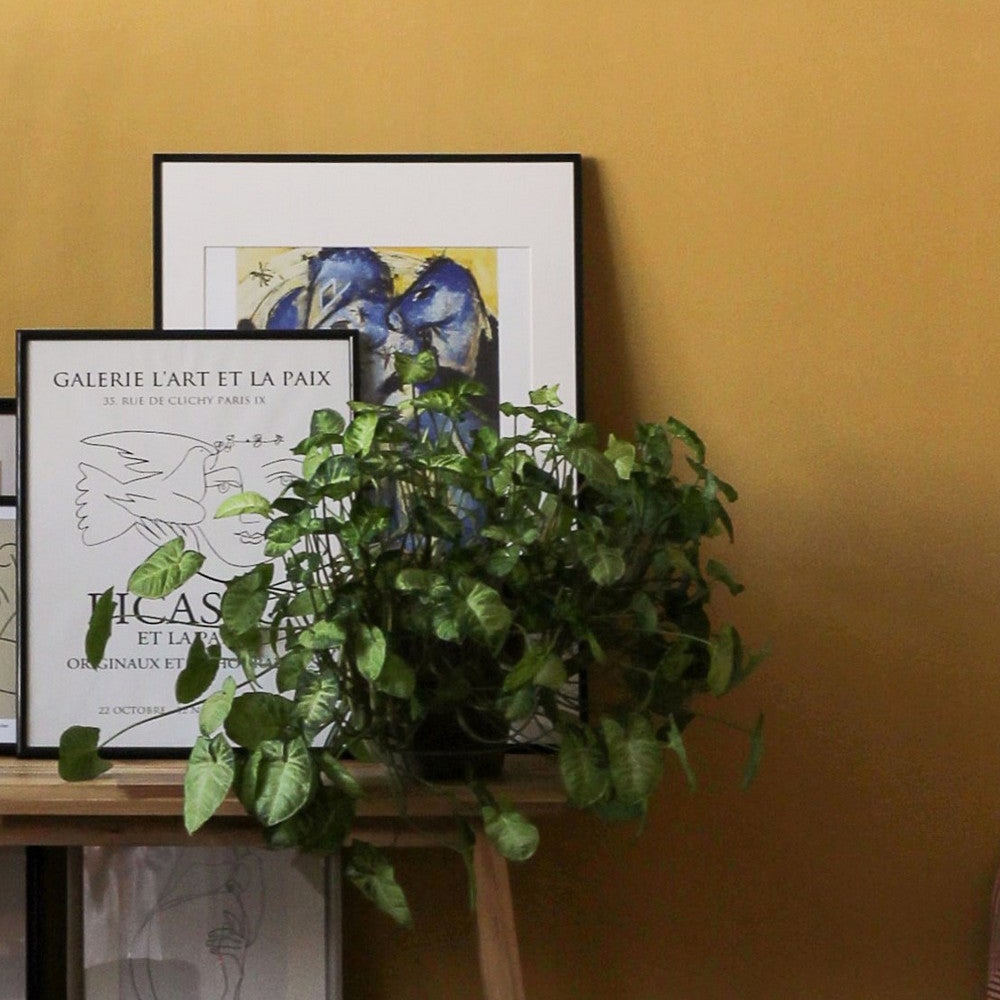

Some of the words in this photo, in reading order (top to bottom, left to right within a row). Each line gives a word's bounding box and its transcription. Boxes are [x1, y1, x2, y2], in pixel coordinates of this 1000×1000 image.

[53, 371, 144, 388] GALERIE
[153, 370, 210, 387] L'ART
[218, 370, 243, 387] ET
[250, 370, 275, 387] LA
[283, 370, 331, 386] PAIX
[121, 396, 145, 406] RUE
[149, 396, 165, 406] DE
[217, 396, 251, 405] PARIS
[138, 631, 162, 646] ET
[168, 631, 191, 646] LA
[66, 657, 160, 670] ORGINAUX
[165, 657, 185, 670] ET
